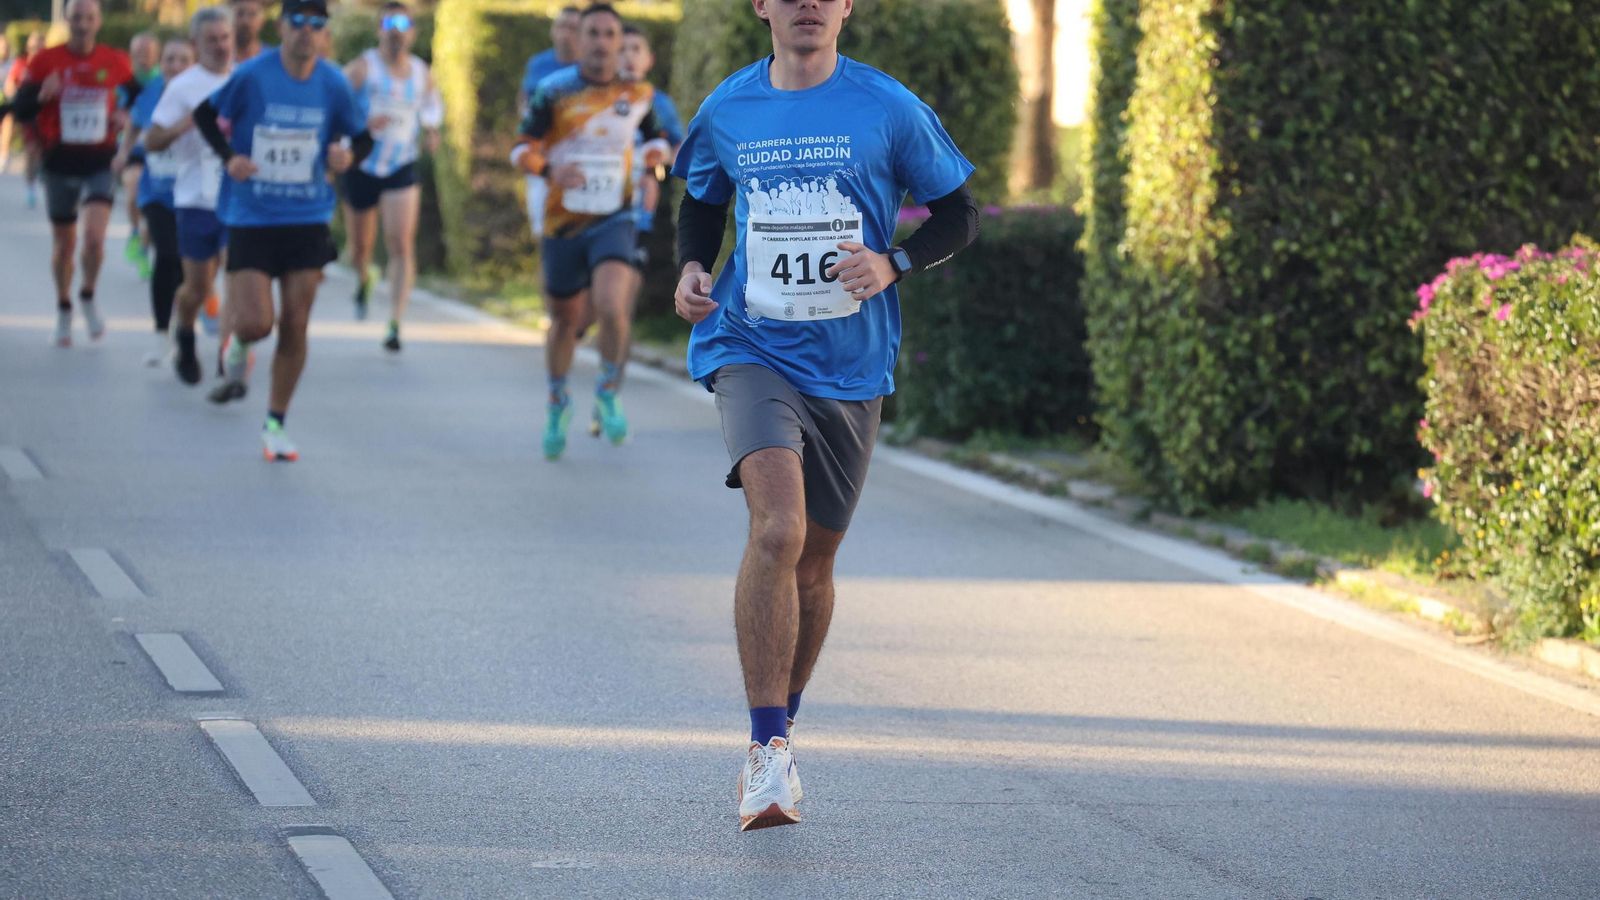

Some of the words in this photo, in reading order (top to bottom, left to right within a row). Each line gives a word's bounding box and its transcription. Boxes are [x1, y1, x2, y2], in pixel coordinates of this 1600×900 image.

[737, 142, 747, 151] VII
[748, 138, 793, 149] CARRERA
[794, 136, 835, 145] URBANA
[837, 135, 851, 144] DE
[265, 147, 300, 165] 415
[737, 149, 792, 167] CIUDAD
[795, 143, 851, 160] JARDÍN
[743, 166, 760, 174] Colegio
[760, 163, 787, 172] Fundación
[787, 162, 805, 170] Unicaja
[770, 251, 839, 286] 416
